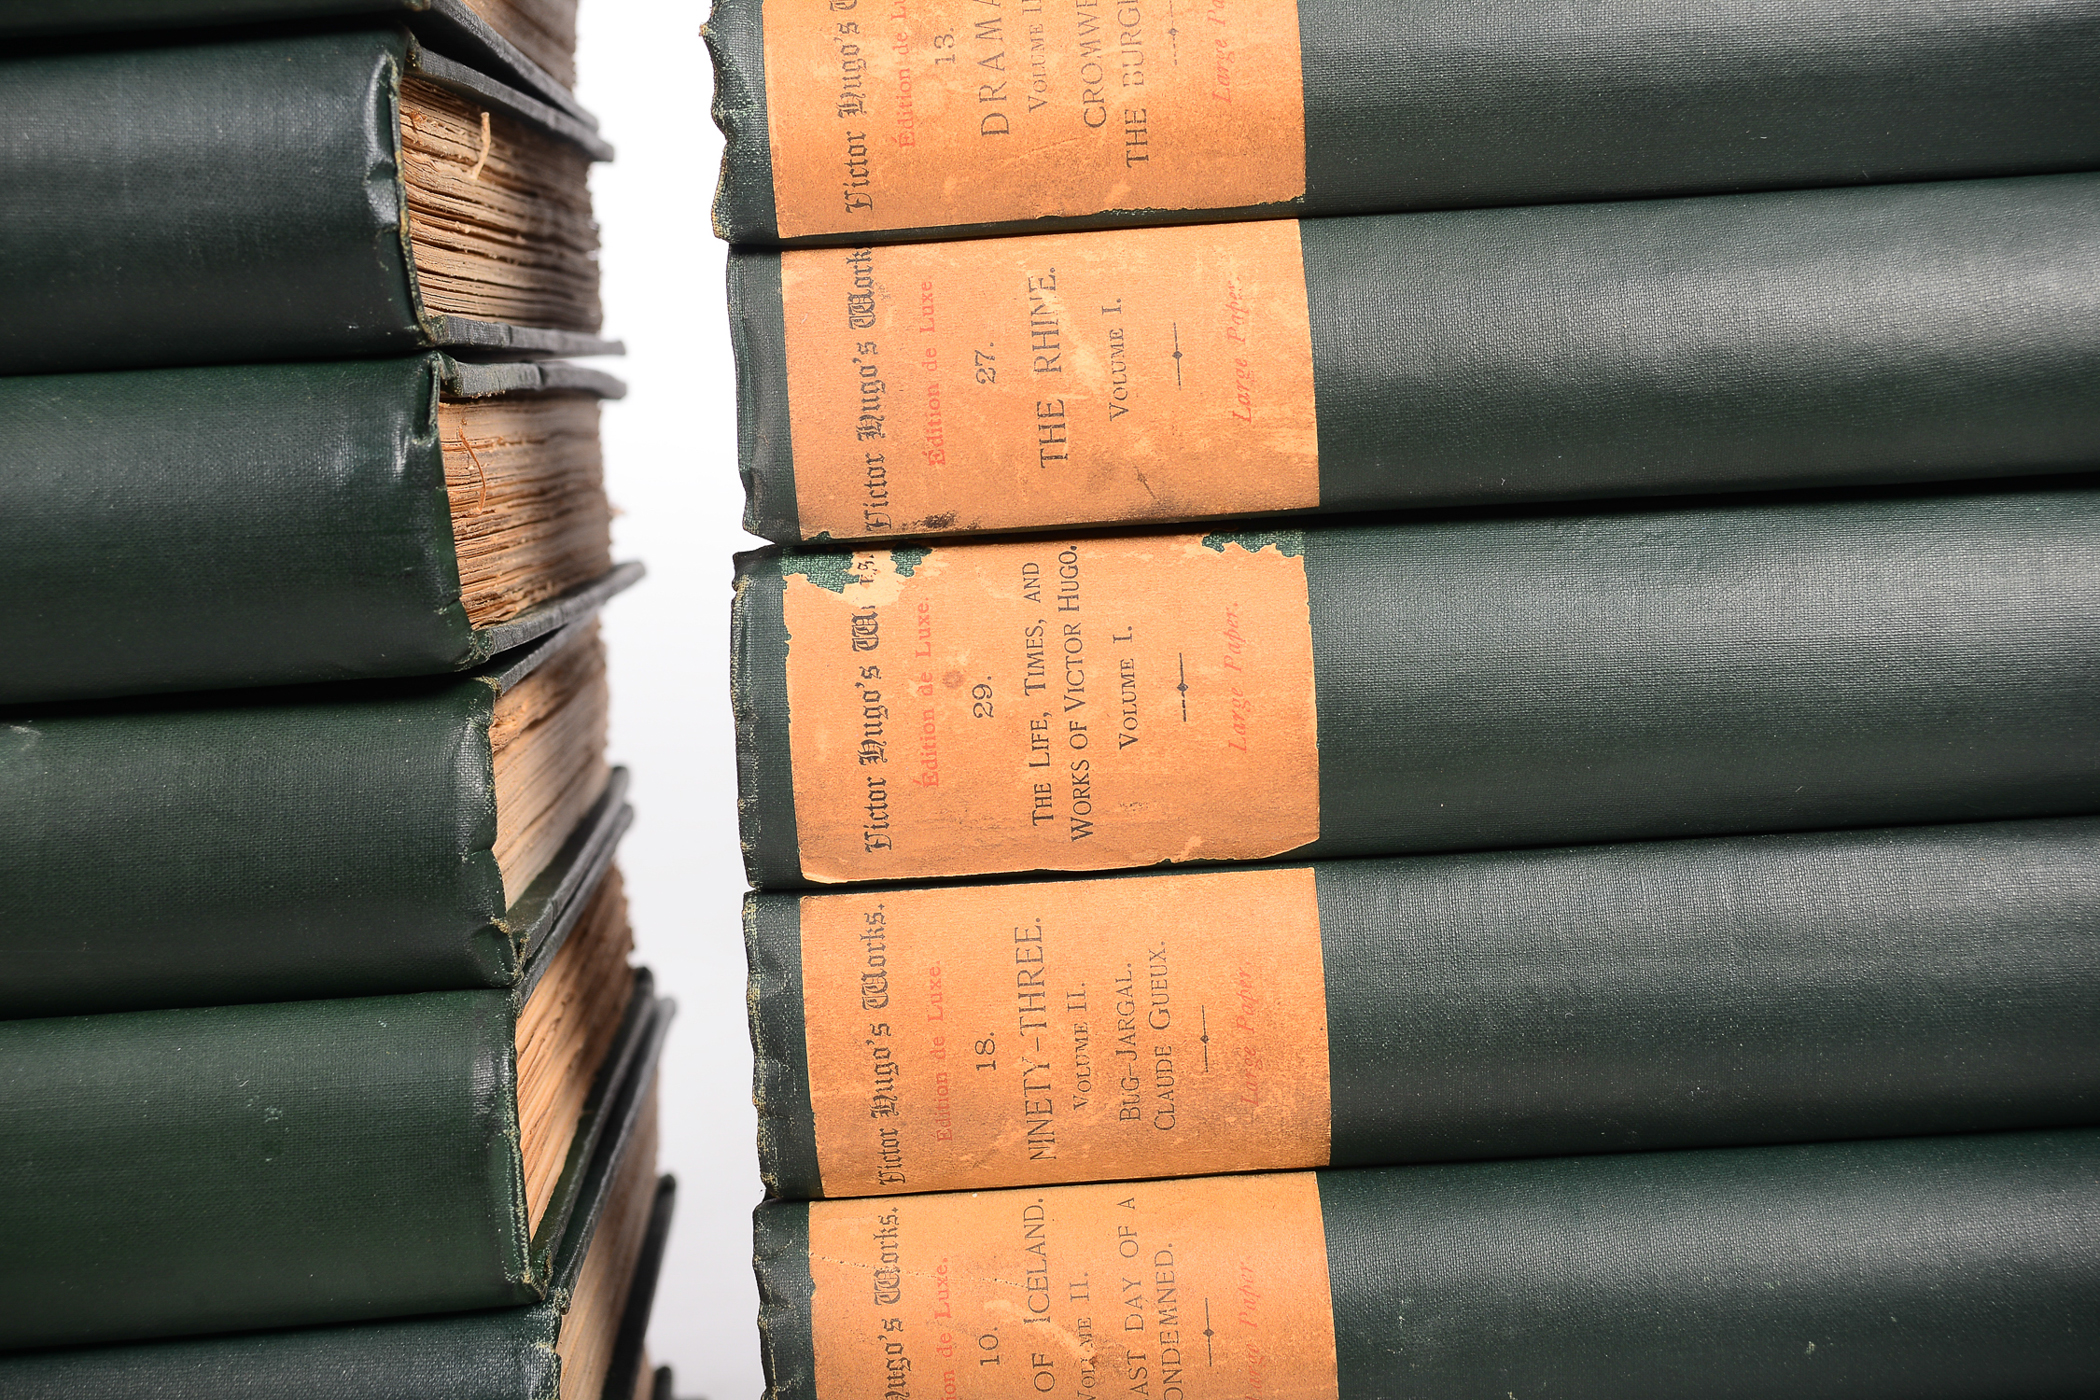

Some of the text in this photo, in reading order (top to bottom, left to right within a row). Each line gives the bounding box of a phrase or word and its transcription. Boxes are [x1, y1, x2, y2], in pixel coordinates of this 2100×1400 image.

[834, 22, 867, 118] Hugo's
[893, 32, 909, 55] de
[934, 27, 955, 64] 13.
[1026, 23, 1049, 112] VOLUME
[1212, 38, 1235, 103] Large
[891, 68, 915, 148] Édition
[1125, 108, 1149, 168] THE
[843, 131, 873, 213] Victor
[845, 246, 891, 531] Victor Hugo's Work
[922, 348, 937, 371] de
[975, 342, 996, 385] 27.
[1102, 298, 1129, 421] VOLUME I.
[1232, 358, 1255, 423] Large
[922, 383, 945, 465] Édition
[1036, 399, 1068, 468] THE
[855, 665, 890, 765] Hugo's
[913, 597, 939, 788] Édition de Luxe.
[973, 676, 994, 719] 29.
[1022, 562, 1053, 826] THE LIFE, TIMES, AND
[1058, 545, 1093, 842] WORKS OF VICTOR HUGO.
[1113, 626, 1138, 750] VOLUME I.
[1221, 601, 1251, 752] Large Paper.
[864, 777, 893, 853] Victor
[860, 904, 905, 1185] Victor Hugo's Works.
[928, 961, 953, 1142] Édition de Luxe.
[975, 1032, 996, 1071] 18.
[1066, 983, 1091, 1110] VOLUME II.
[1115, 963, 1141, 1121] BUG-JARGAL.
[1148, 941, 1175, 1130] CLAUDE GUEUX.
[1240, 1046, 1263, 1106] Large
[1117, 1197, 1135, 1210] A
[1118, 1225, 1140, 1258] OF
[873, 1206, 902, 1305] Works.
[933, 1257, 953, 1318] Luxe.
[1023, 1198, 1055, 1392] OF ICELAND.
[1070, 1272, 1089, 1301] II.
[1123, 1277, 1145, 1331] DAY
[936, 1332, 953, 1358] de
[978, 1327, 1000, 1366] 10.
